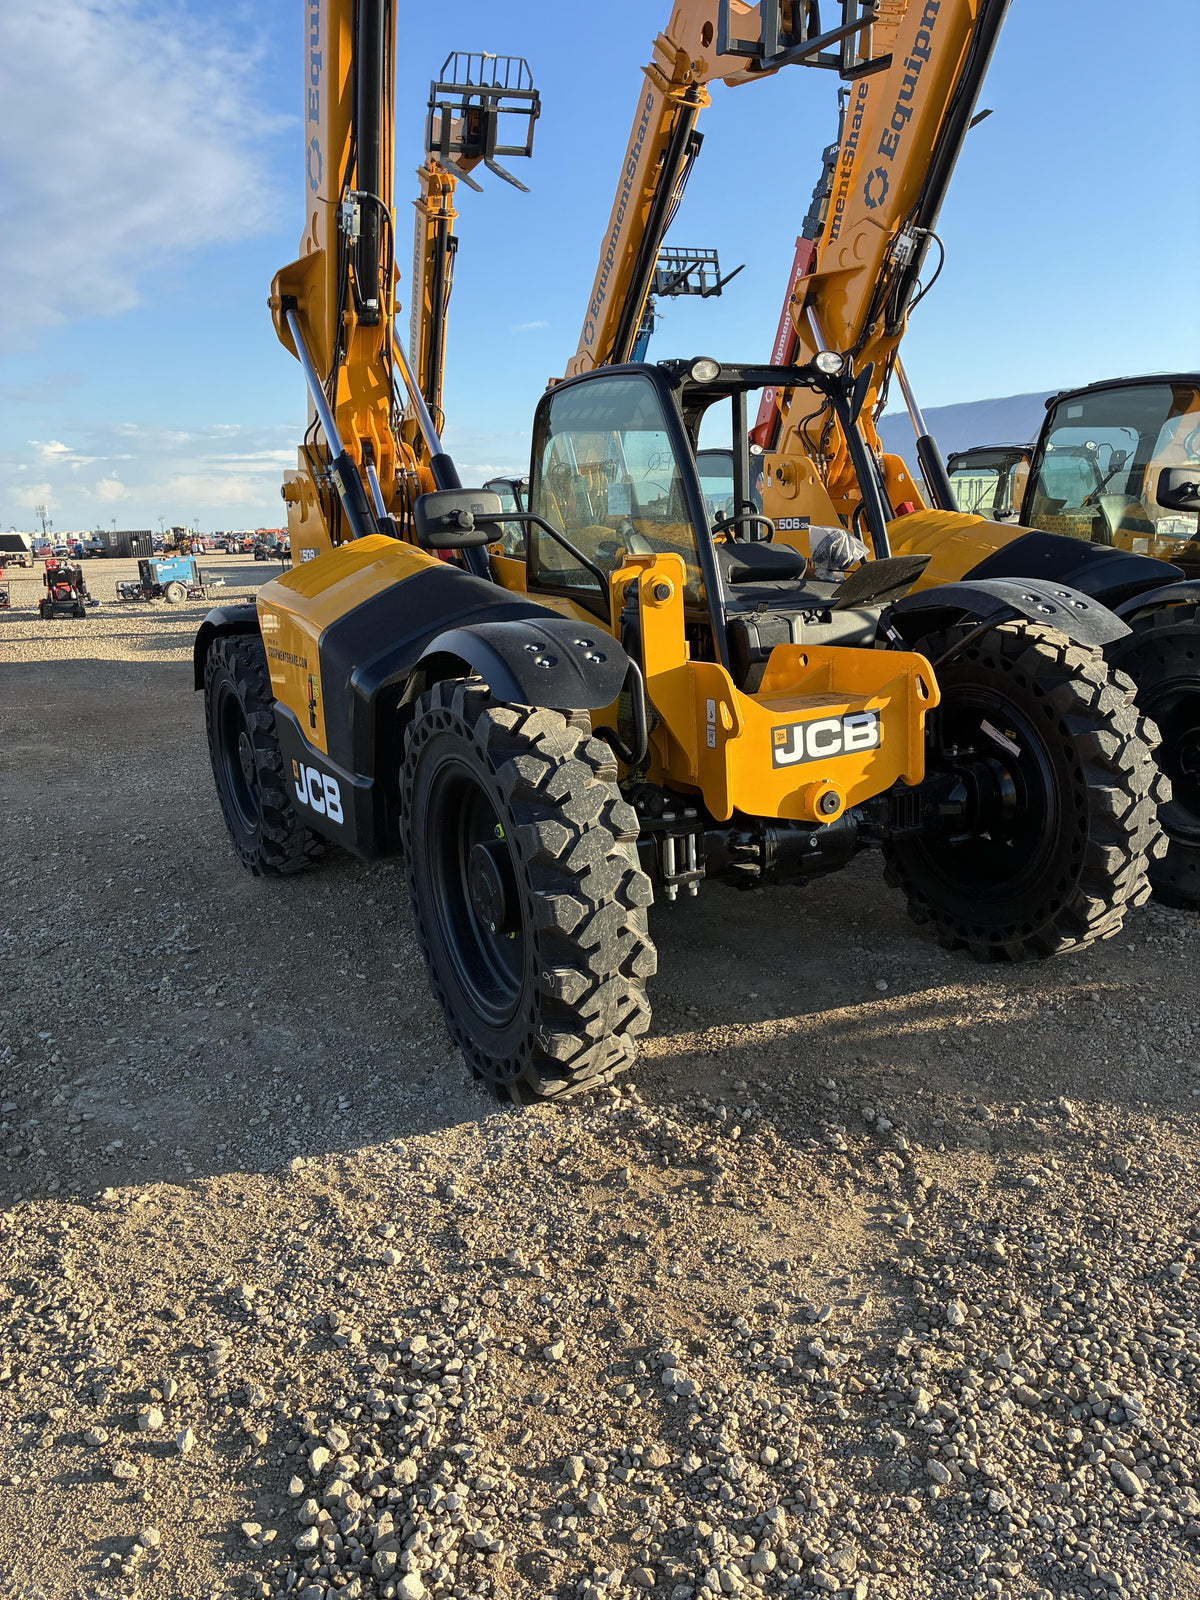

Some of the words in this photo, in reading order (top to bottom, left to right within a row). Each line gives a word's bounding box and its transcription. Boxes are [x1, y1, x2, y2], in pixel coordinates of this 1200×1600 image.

[590, 91, 654, 322] EquipmentShare
[775, 713, 878, 764] JCB
[295, 762, 344, 824] JCB
